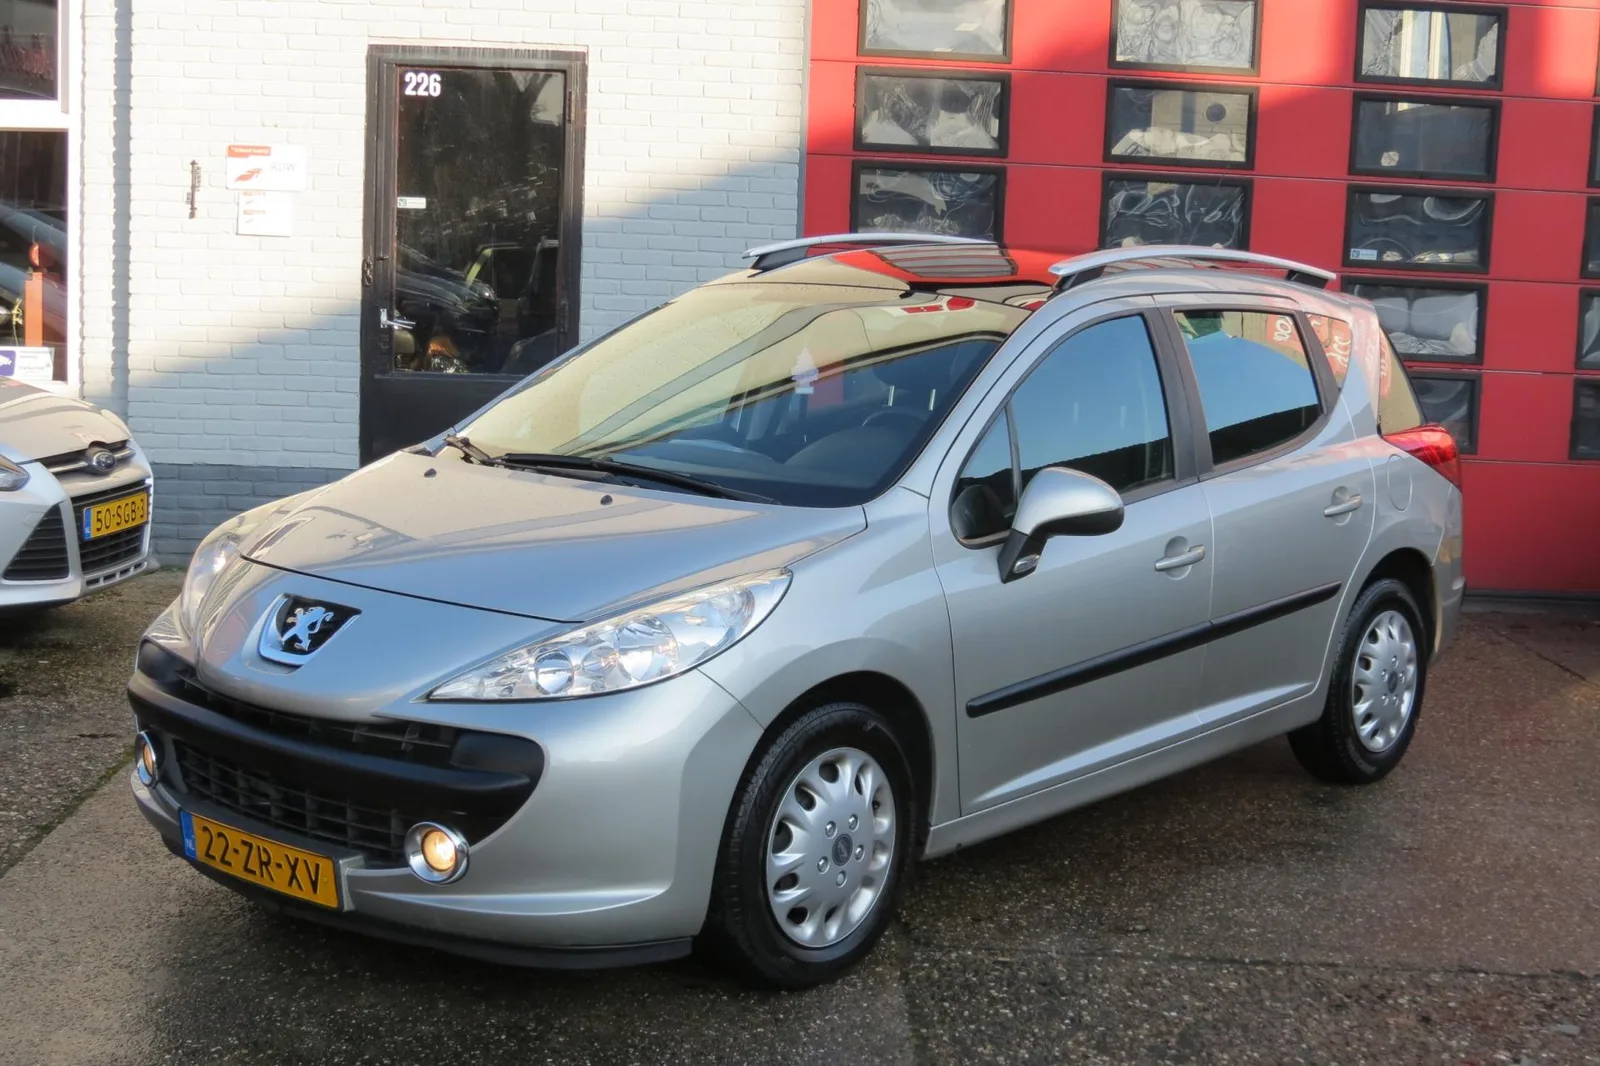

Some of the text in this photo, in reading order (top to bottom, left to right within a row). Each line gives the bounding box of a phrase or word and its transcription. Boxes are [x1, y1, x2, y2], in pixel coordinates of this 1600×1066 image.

[404, 71, 442, 97] 226
[96, 498, 145, 532] 50-SGB-3
[202, 825, 320, 894] 22-ZR-XV
